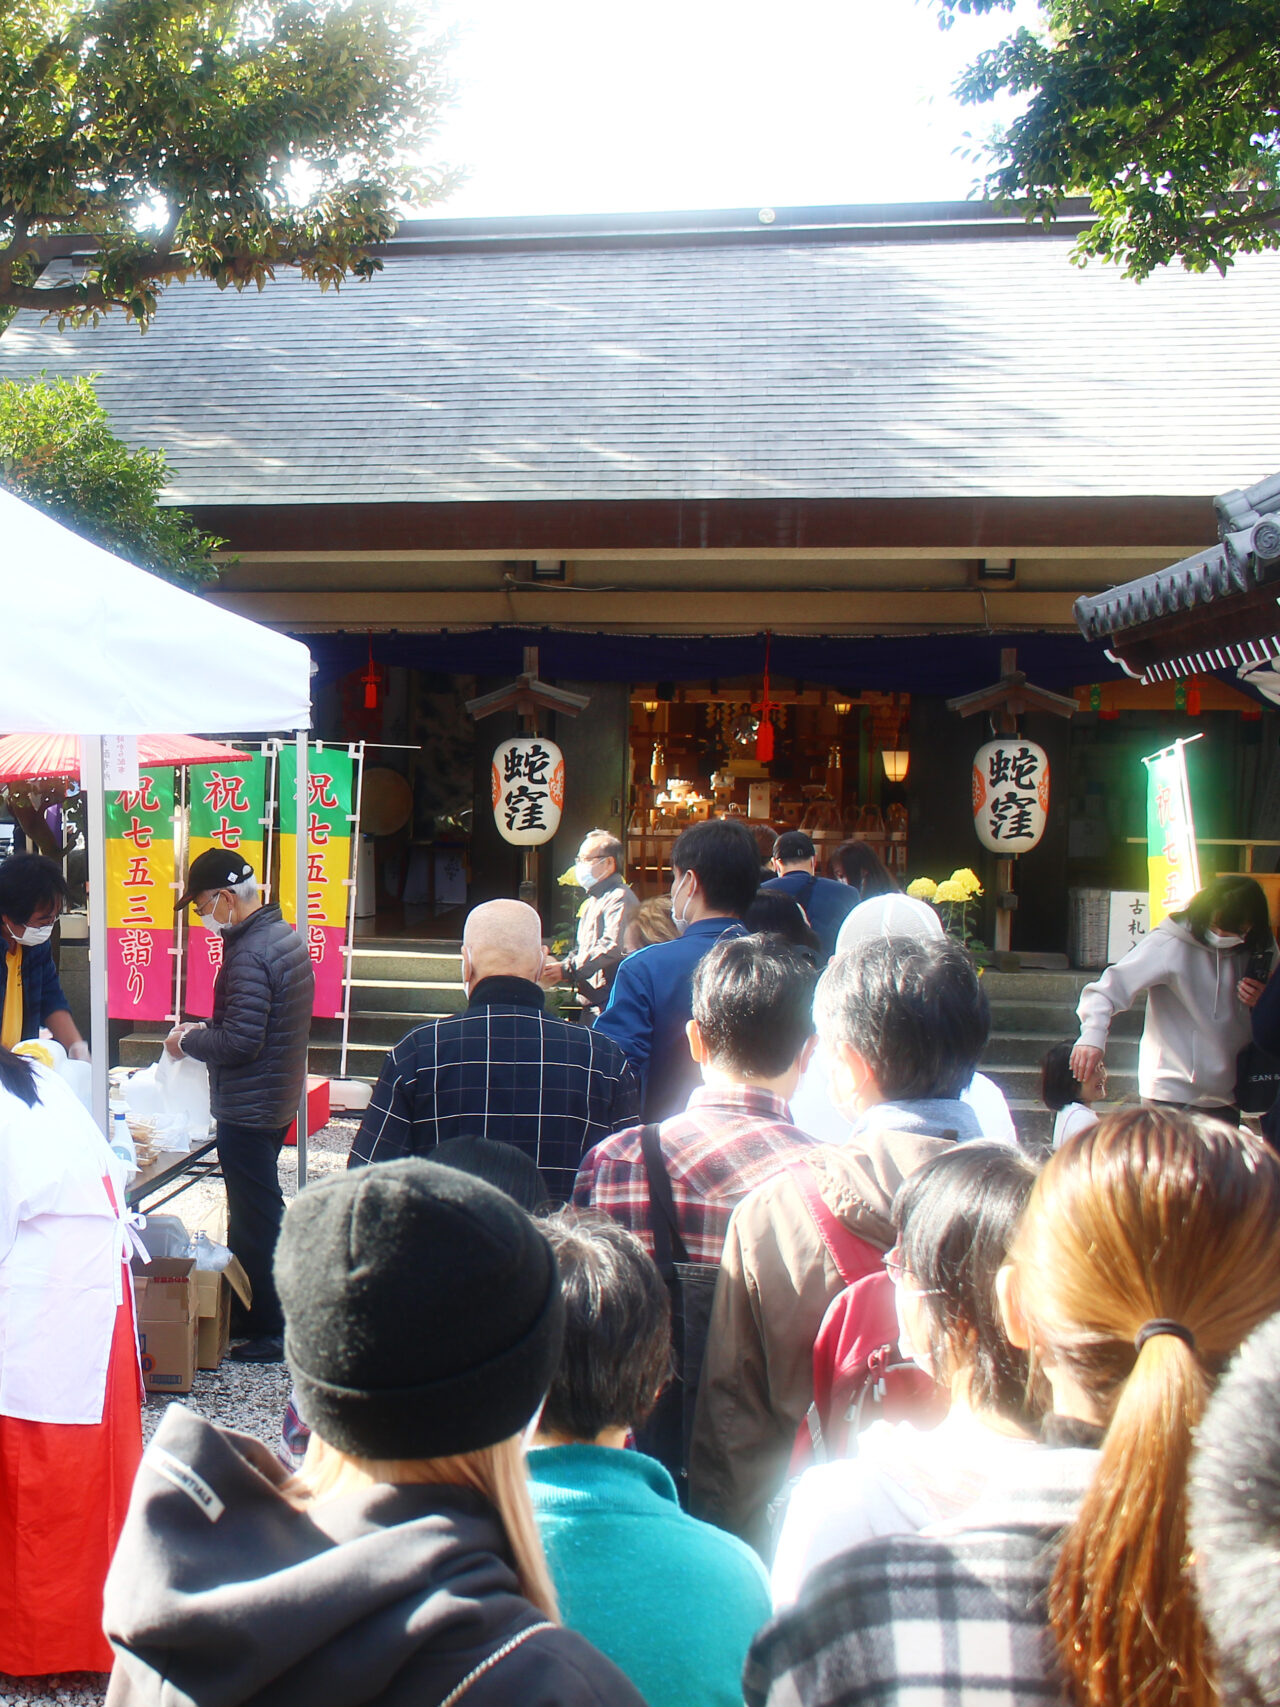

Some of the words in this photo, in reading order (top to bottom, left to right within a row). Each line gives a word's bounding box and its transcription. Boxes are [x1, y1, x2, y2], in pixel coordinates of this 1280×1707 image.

[504, 744, 550, 831] 蛇窪
[988, 747, 1038, 840] 蛇窪
[115, 774, 160, 1004] 祝七五三詣り
